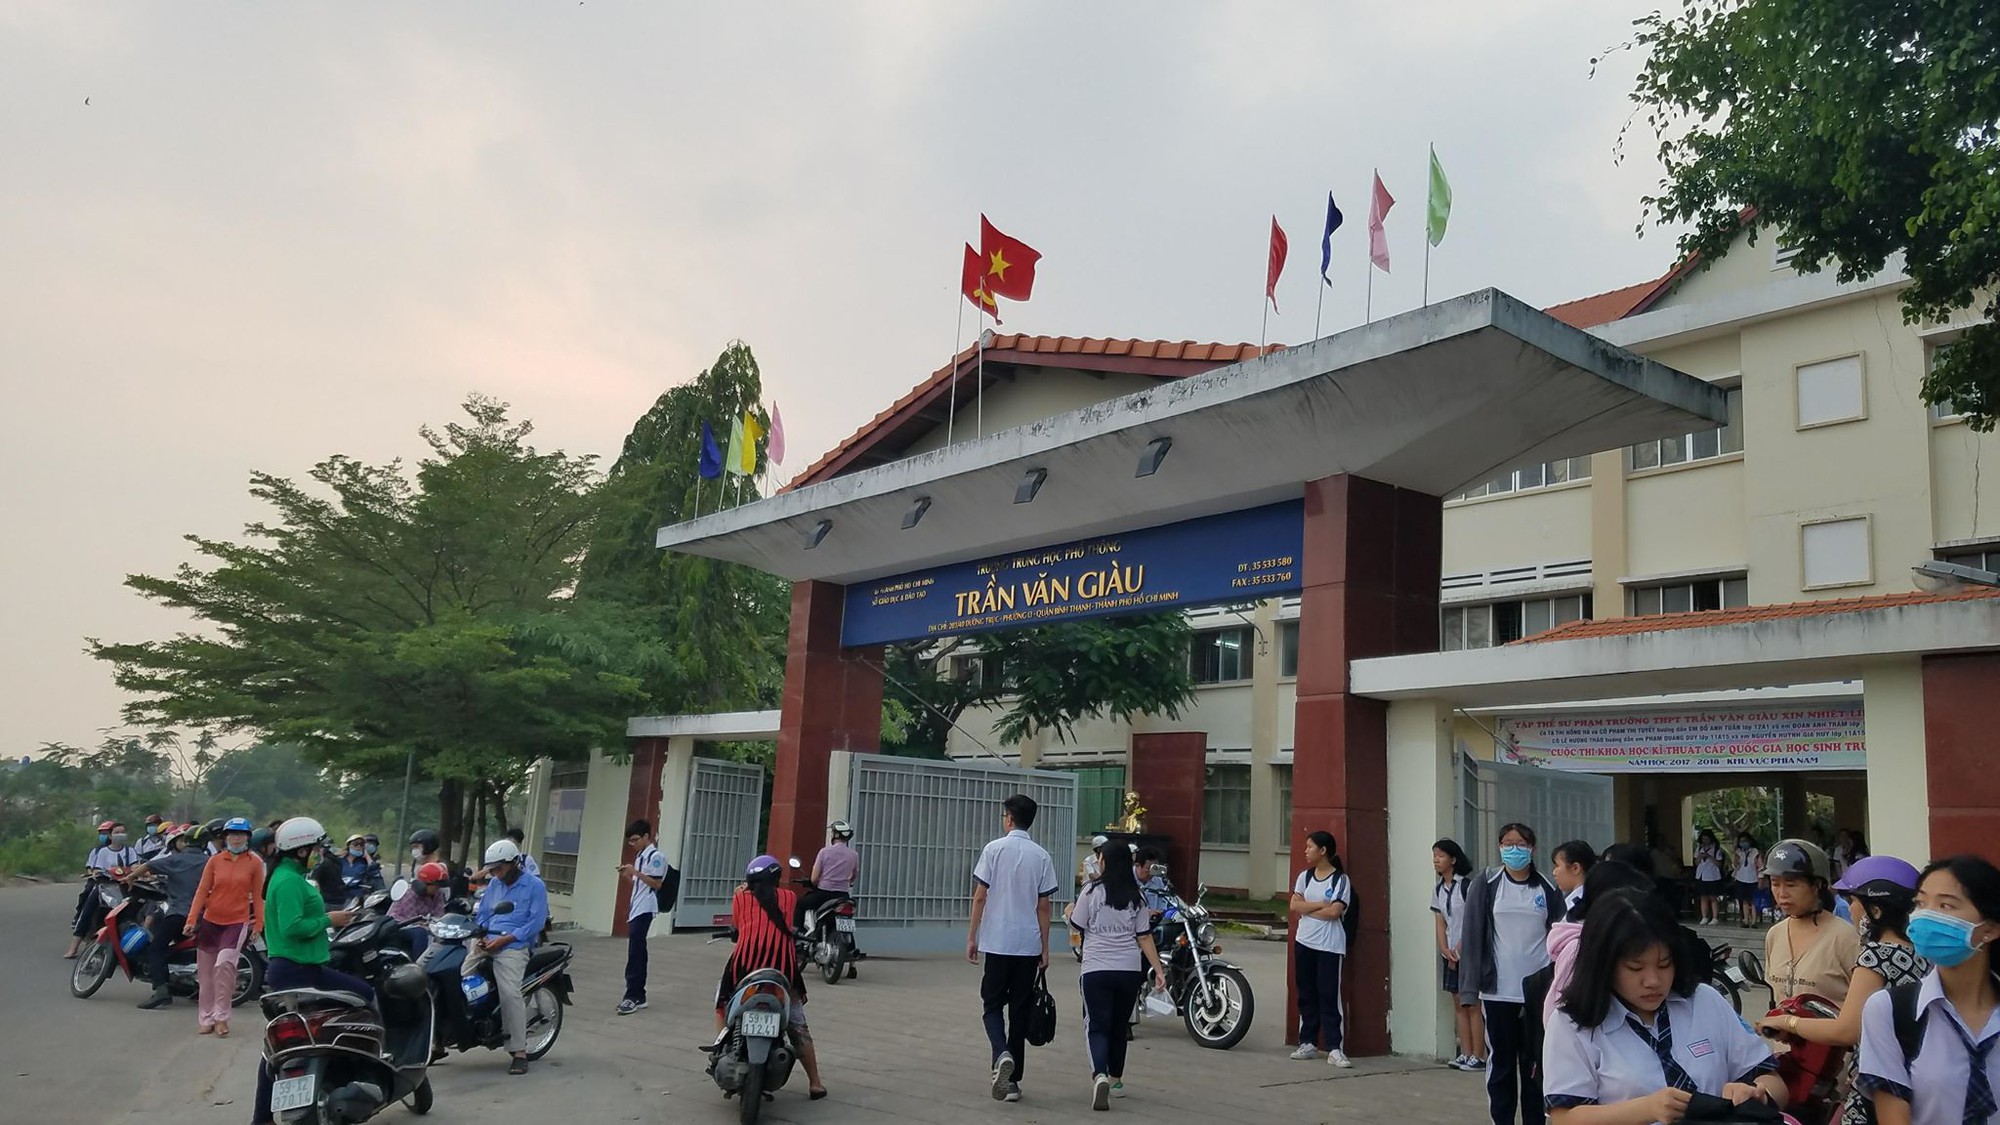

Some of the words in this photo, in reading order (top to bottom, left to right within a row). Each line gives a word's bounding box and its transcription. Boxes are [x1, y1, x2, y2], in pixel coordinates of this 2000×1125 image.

[1012, 554, 1041, 569] TRUNG
[1042, 550, 1064, 566] HỌC
[1065, 544, 1085, 560] PHỔ
[1088, 539, 1122, 555] THÔNG
[1252, 561, 1261, 571] 35
[1262, 559, 1276, 569] 533
[1277, 556, 1293, 566] 580
[1252, 575, 1261, 585] 35
[1261, 574, 1275, 583] 533
[1277, 572, 1292, 582] 760
[955, 574, 1015, 617] TRẦN
[1022, 572, 1070, 607] VĂN
[1077, 560, 1145, 600] GIÀU
[1036, 606, 1054, 618] QUẬN
[1054, 603, 1069, 615] BÌNH
[1070, 603, 1092, 614] THẠNH
[1094, 599, 1118, 609] THÀNH
[1119, 593, 1133, 606] PHỐ
[1133, 592, 1144, 605] HỒ
[1145, 591, 1159, 604] CHÍ
[1159, 591, 1179, 601] MINH
[1606, 716, 1649, 726] TRƯỜNG
[1654, 716, 1681, 725] THPT
[1684, 712, 1716, 724] TRẦN
[1748, 711, 1779, 721] GIÀU
[1782, 711, 1804, 720] XIN
[1816, 730, 1830, 738] HUY
[1551, 746, 1577, 758] CUỘC
[1579, 748, 1595, 757] THI
[1596, 747, 1626, 757] KHOA
[1628, 746, 1649, 758] HỌC
[1666, 743, 1702, 757] THUẬT
[1704, 741, 1726, 754] CẤP
[1728, 740, 1760, 755] QUỐC
[1762, 744, 1783, 753] GIA
[1786, 743, 1810, 755] HỌC
[1812, 742, 1842, 752] SINH
[1669, 758, 1691, 766] 2017
[1697, 758, 1720, 766] 2018
[1727, 757, 1748, 765] KHU
[1796, 756, 1819, 764] NAM
